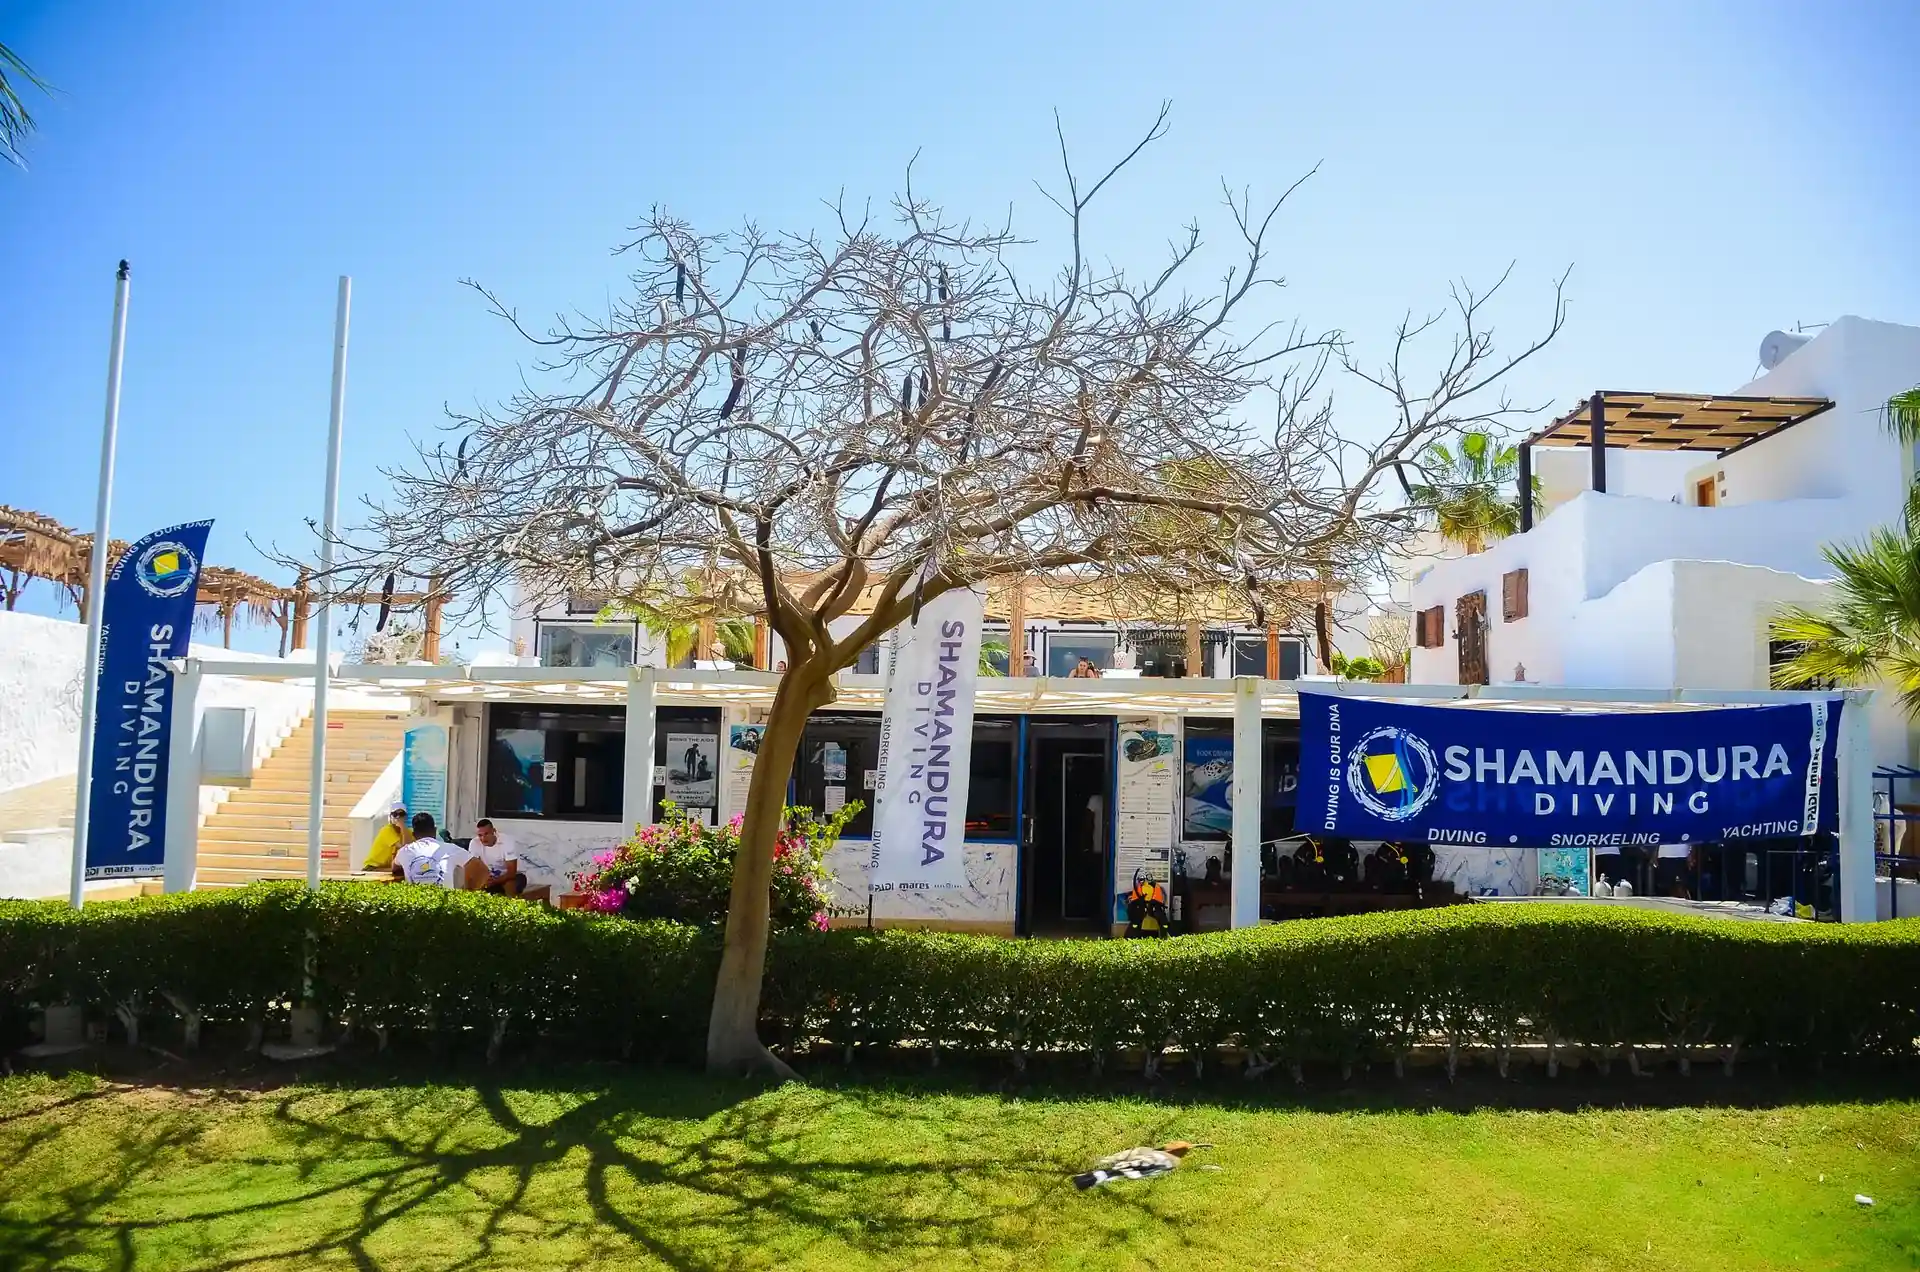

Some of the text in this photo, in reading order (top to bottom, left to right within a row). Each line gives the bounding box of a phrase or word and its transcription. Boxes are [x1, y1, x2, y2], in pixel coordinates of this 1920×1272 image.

[111, 520, 212, 580] DIVING IS OUR DNA
[113, 681, 141, 795] DIVING
[126, 623, 174, 852] SHAMANDURA
[877, 717, 892, 790] SNORKELING
[908, 682, 932, 804] DIVING
[920, 620, 965, 867] SHAMANDURA
[1324, 704, 1341, 830] DIVING IS OUR DNA
[1443, 743, 1793, 786] SHAMANDURA
[1535, 791, 1710, 817] DIVING
[1807, 793, 1818, 821] PADI
[871, 830, 881, 868] DIVING
[1427, 828, 1487, 844] DIVING
[1550, 832, 1661, 847] SNORKELING
[1722, 819, 1799, 839] YACHTING
[104, 866, 135, 876] mares
[898, 882, 930, 892] mares
